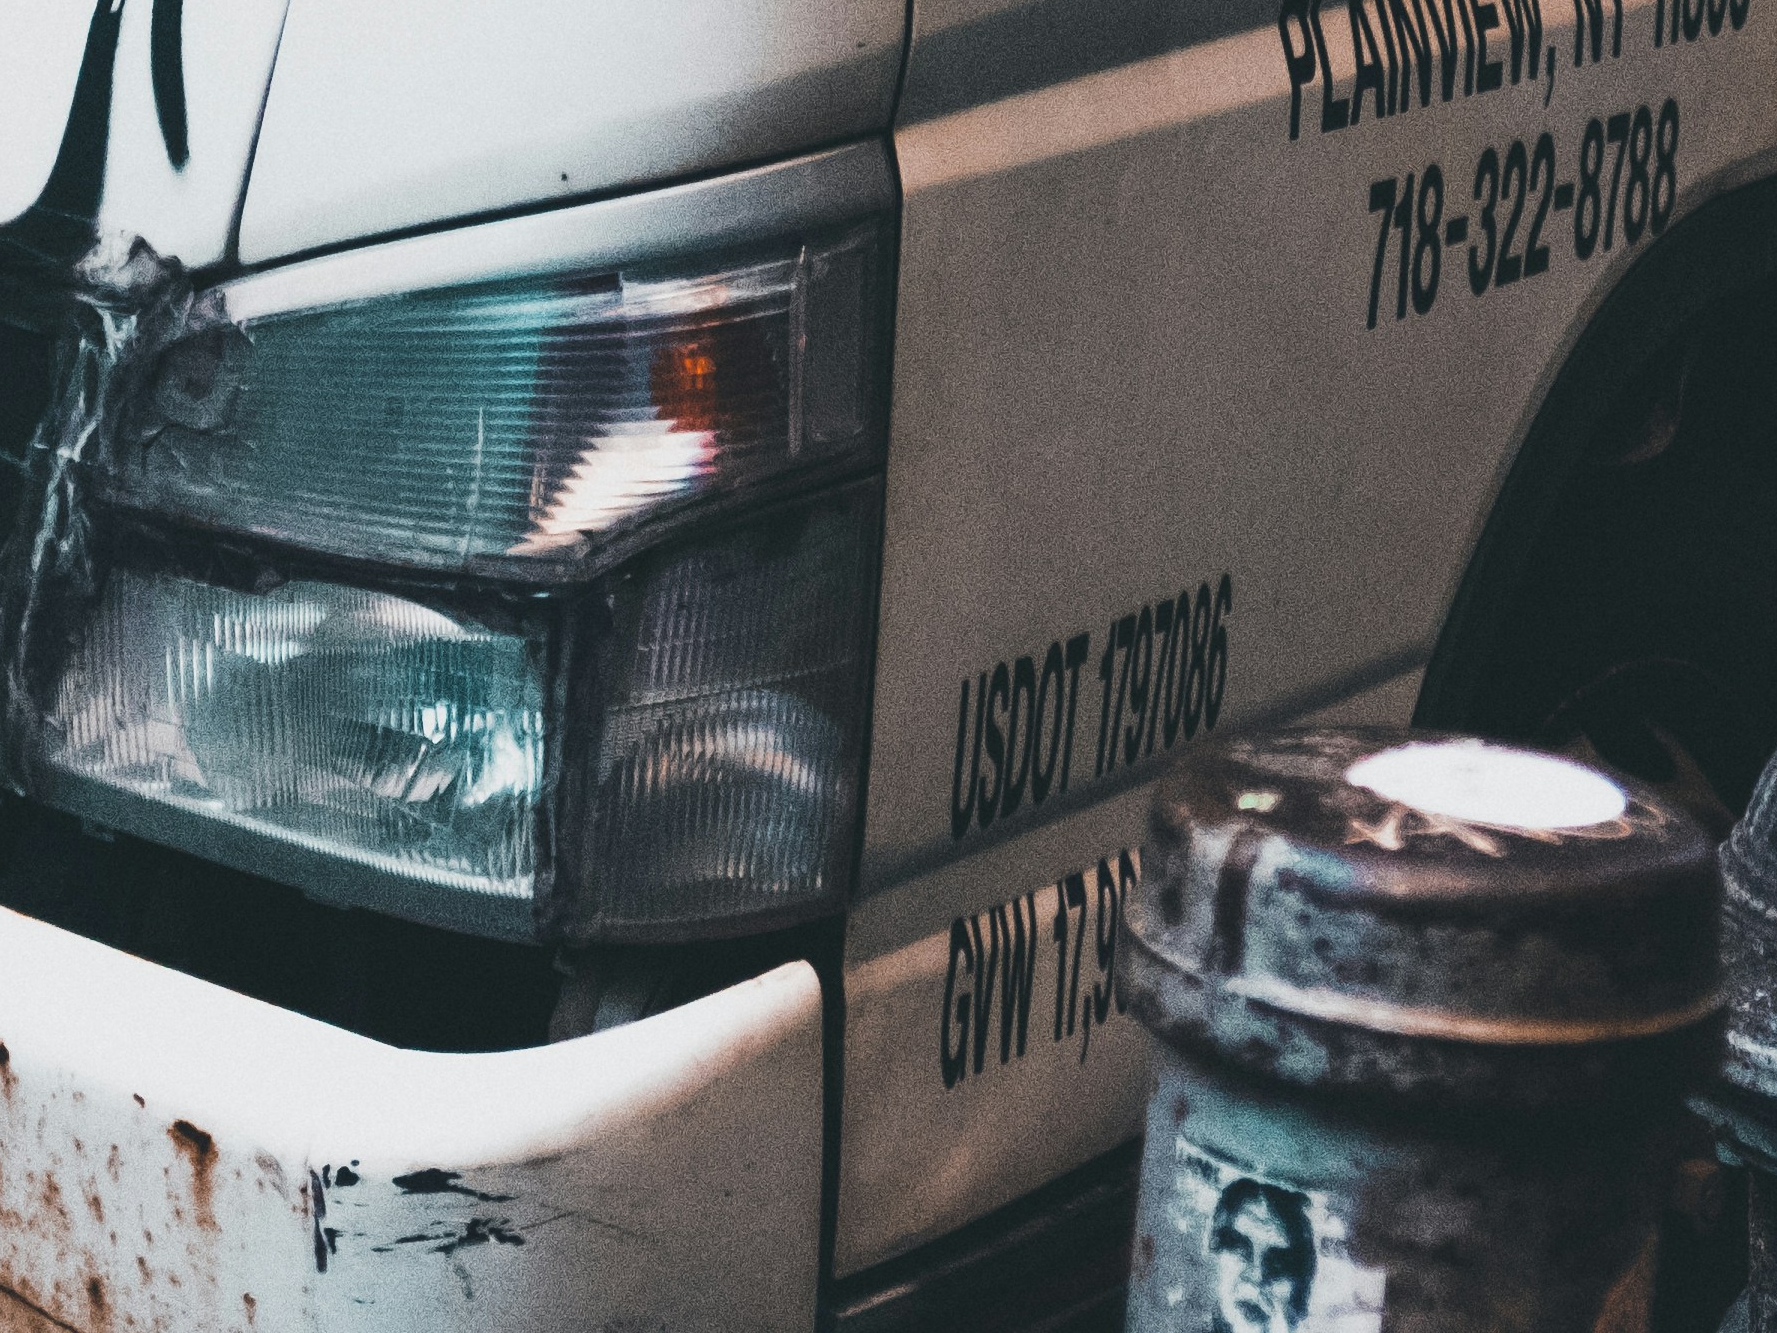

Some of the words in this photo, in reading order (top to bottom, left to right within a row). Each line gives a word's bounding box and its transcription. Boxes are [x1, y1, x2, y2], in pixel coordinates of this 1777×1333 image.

[1366, 95, 1679, 332] 718-322-8788
[951, 632, 1090, 841] USDOT
[1095, 572, 1232, 778] 1797086
[940, 889, 1038, 1090] GVW
